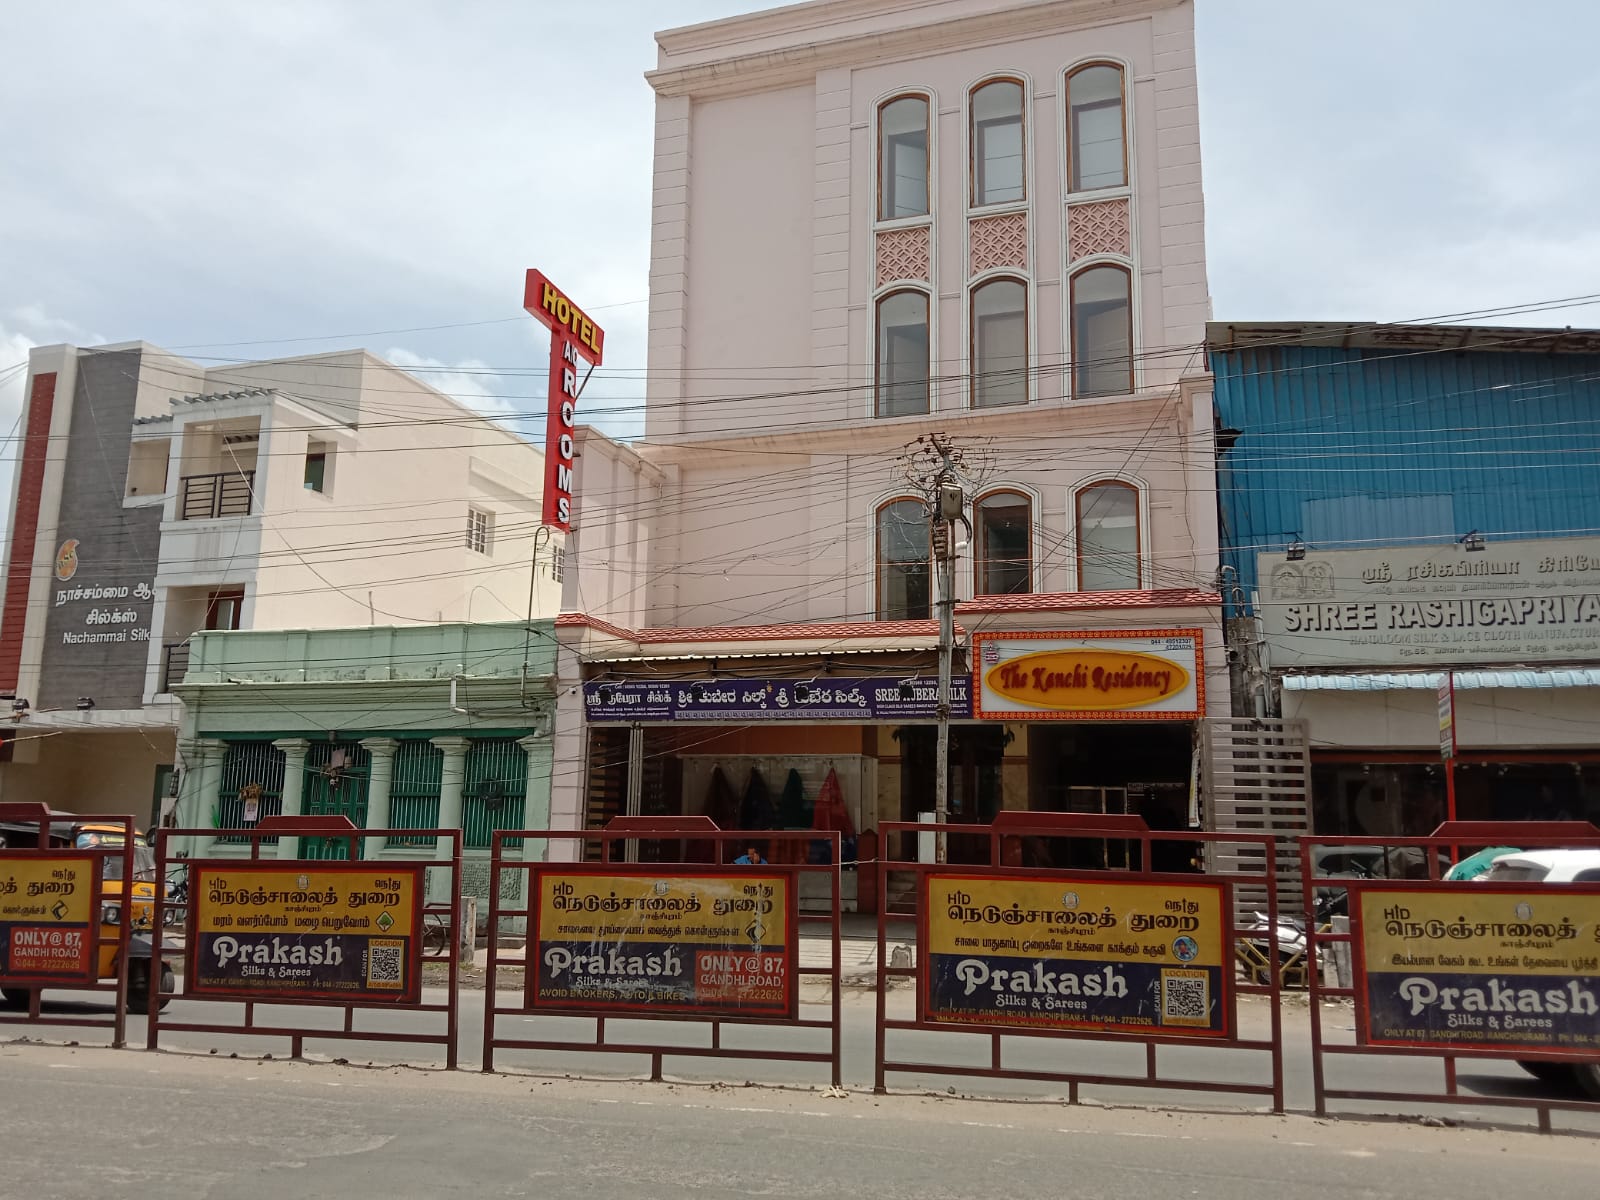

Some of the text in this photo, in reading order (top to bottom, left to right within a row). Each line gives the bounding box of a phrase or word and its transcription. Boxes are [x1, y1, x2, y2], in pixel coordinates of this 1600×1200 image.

[542, 283, 600, 354] HOTEL
[557, 367, 576, 524] ROOMS
[56, 584, 128, 607] நாச்சம்மை
[86, 608, 137, 625] சில்க்ஸ்
[1285, 594, 1600, 632] SHREE RASHIGAPRIYA
[63, 628, 127, 644] Nachammai
[1484, 630, 1521, 642] CLOTH
[1000, 662, 1171, 696] The Kanchi Residency
[875, 688, 901, 701] SREE
[27, 881, 75, 897] துறை
[209, 886, 400, 908] நெடுஞ்சாலைத் துறை
[553, 891, 773, 916] நெடுஞ்சாலைத் துறை
[212, 914, 370, 930] மரம் வளர்ப்போம் மழை பெறுவோம்
[948, 903, 1199, 933] நெடுஞ்சாலைத் துறை
[1385, 916, 1577, 941] நெடுஞ்சாலைத்
[14, 947, 49, 957] GANDHI
[212, 935, 343, 968] Prakash
[955, 937, 979, 947] சாலை
[982, 937, 1019, 952] பாதுகாப்பு
[1107, 942, 1140, 955] காக்கும்
[544, 946, 682, 979] Prakash
[764, 957, 785, 976] 87,
[1488, 955, 1519, 967] உங்கள்
[241, 965, 311, 978] Silks & Sarees
[700, 974, 745, 985] GANDHI
[955, 958, 1129, 998] Prakash
[1165, 970, 1205, 978] LOCATION
[576, 975, 601, 987] Silks
[540, 988, 568, 997] AVOID
[1399, 977, 1599, 1016] Prakash
[995, 993, 1087, 1010] Silks & Sarees
[1447, 1013, 1553, 1029] Silks & Sarees
[1384, 1028, 1404, 1036] ONLY
